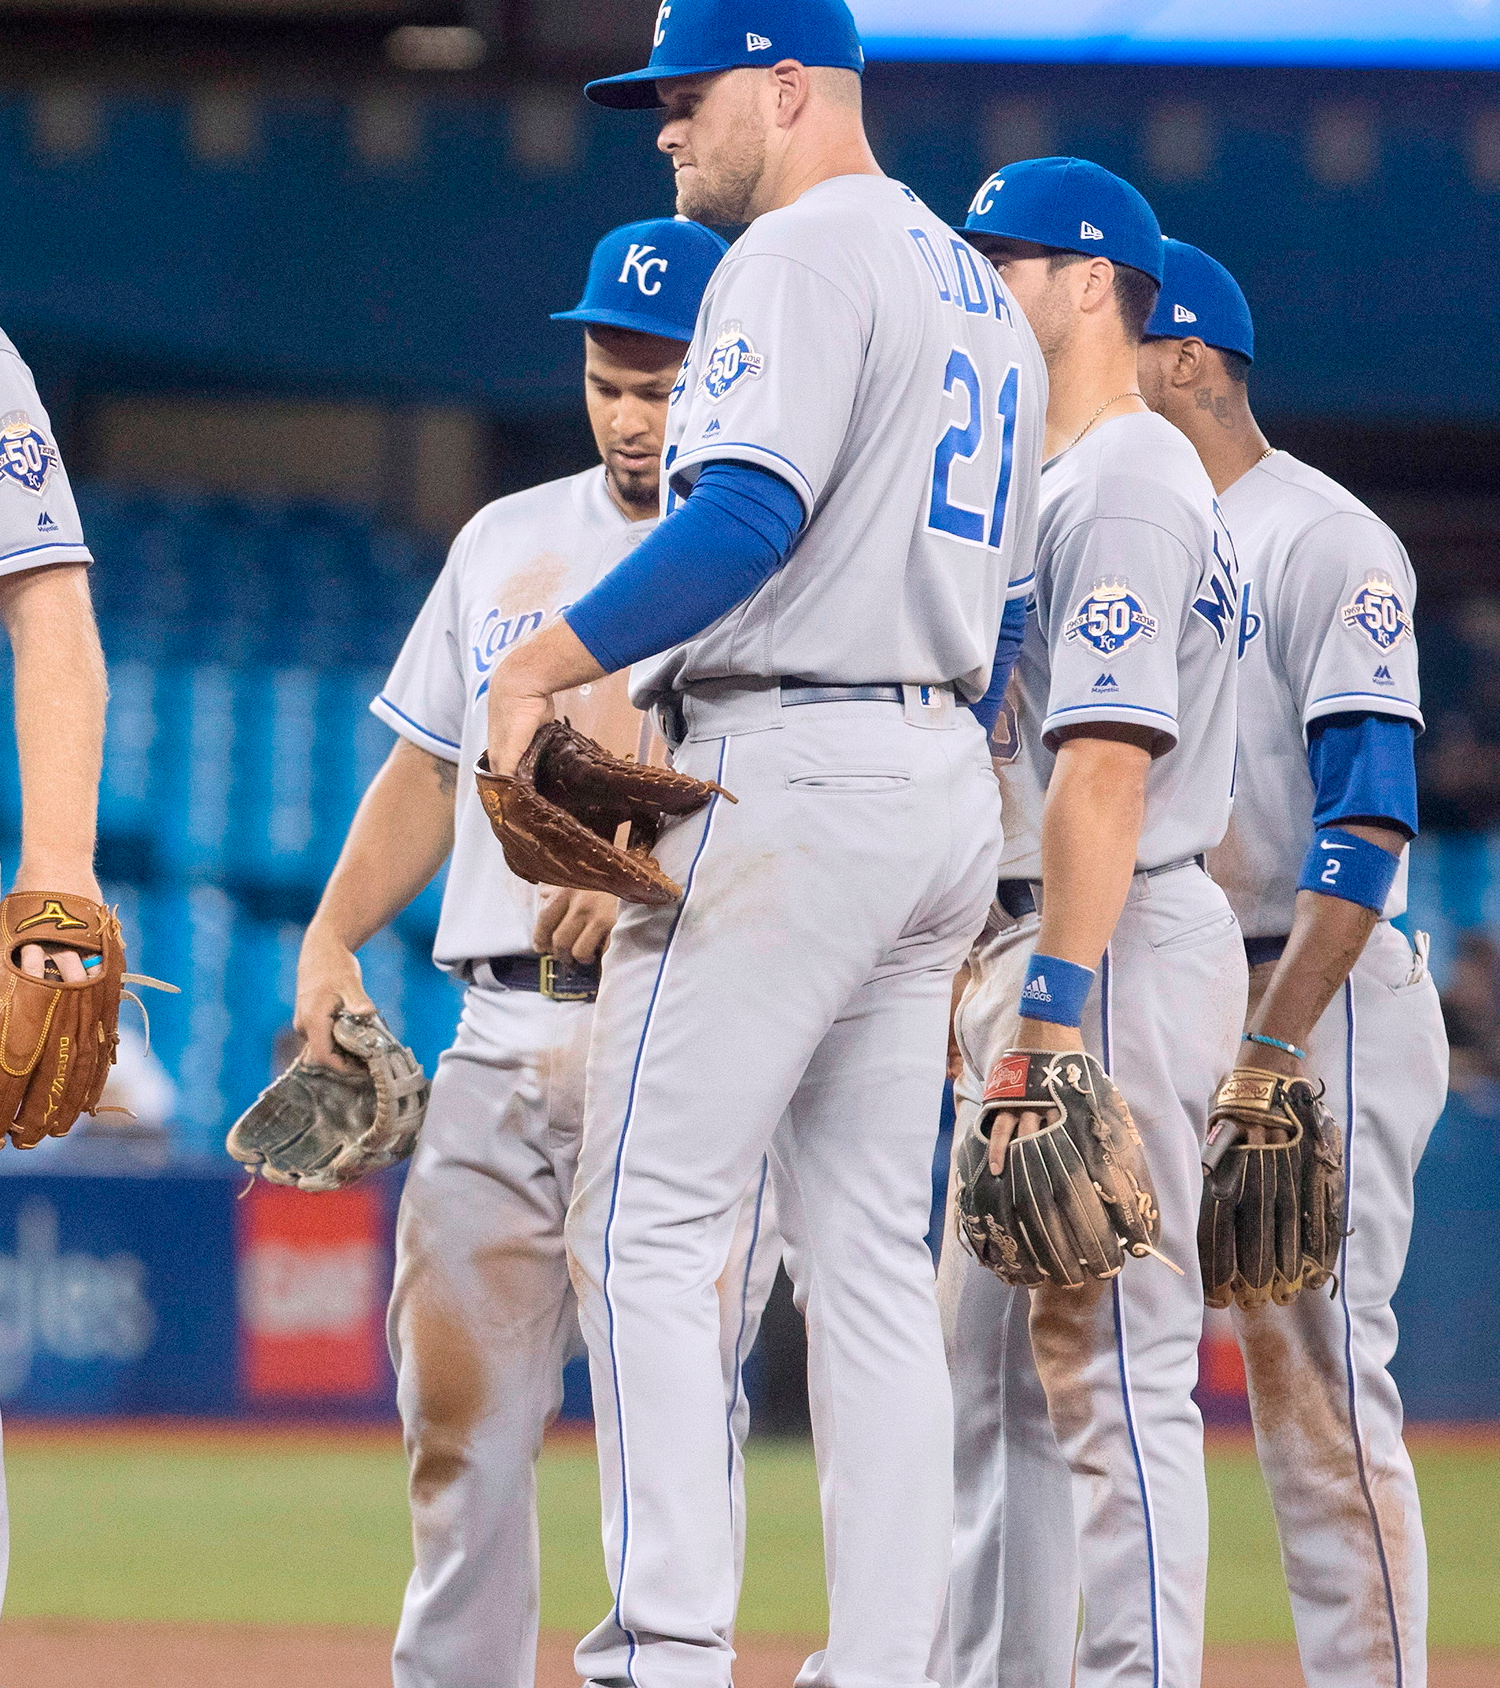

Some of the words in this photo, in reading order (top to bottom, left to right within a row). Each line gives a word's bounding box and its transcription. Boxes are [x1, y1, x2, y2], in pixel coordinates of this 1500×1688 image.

[617, 243, 668, 296] KC
[710, 345, 740, 383] 50
[4, 437, 42, 476] 50
[923, 344, 1022, 554] 21
[26, 472, 41, 489] KC
[1088, 601, 1130, 637] 50
[1135, 614, 1156, 628] 2018
[1343, 606, 1361, 616] 1969
[1364, 595, 1397, 632] 50
[1100, 634, 1116, 651] KC
[1377, 629, 1390, 646] KC
[1321, 858, 1340, 885] 2
[1022, 989, 1053, 1003] adidas
